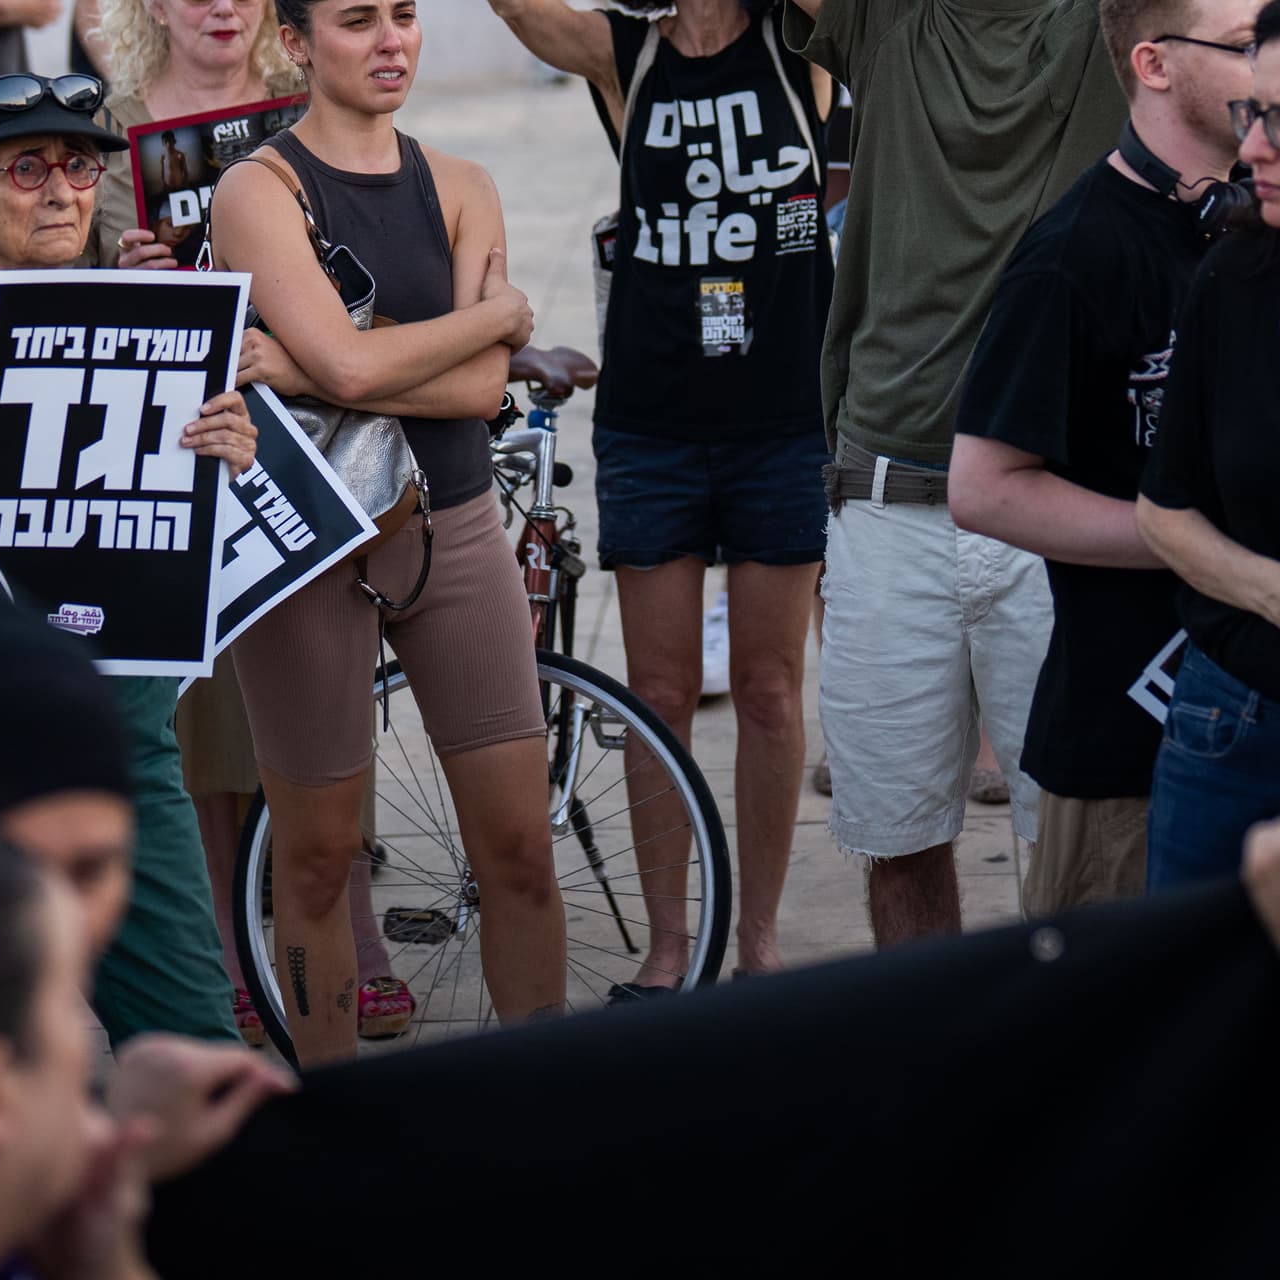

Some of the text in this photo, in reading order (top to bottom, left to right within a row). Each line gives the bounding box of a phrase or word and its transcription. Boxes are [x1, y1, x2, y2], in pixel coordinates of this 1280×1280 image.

[644, 90, 763, 149] חיים
[633, 200, 758, 267] Life
[10, 326, 213, 363] עומדים ביחד
